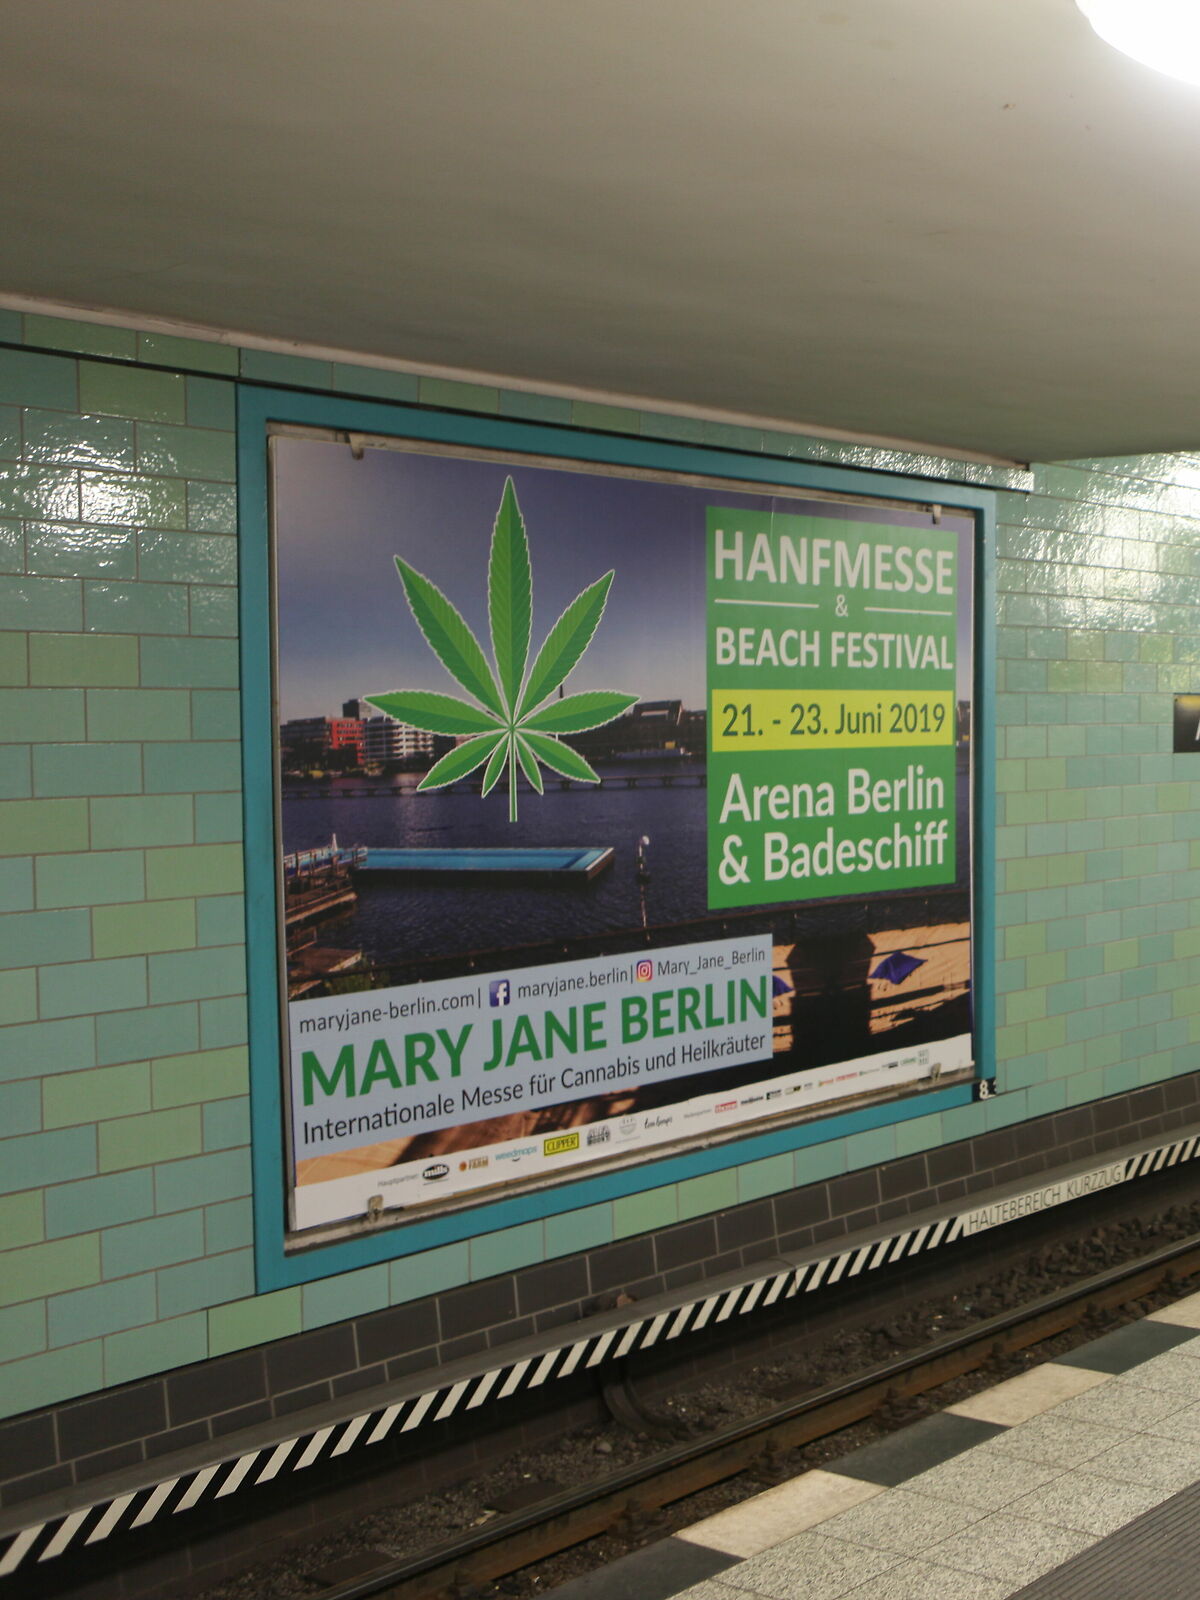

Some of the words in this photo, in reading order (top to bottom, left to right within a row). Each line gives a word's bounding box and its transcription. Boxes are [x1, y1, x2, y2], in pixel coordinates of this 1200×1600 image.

[715, 529, 953, 595] HANFMESSE
[834, 594, 849, 617] &
[716, 626, 820, 667] BEACH
[831, 631, 953, 670] FESTIVAL
[722, 703, 763, 737] 21.
[790, 703, 828, 735] 23.
[835, 703, 882, 735] Juni
[889, 703, 945, 733] 2019
[719, 773, 835, 824] Arena
[848, 765, 944, 815] Berlin
[718, 834, 751, 885] &
[764, 819, 948, 881] Badeschiff
[657, 948, 765, 976] Mary_Jane_Berlin
[301, 1023, 475, 1107] MARY
[483, 1001, 607, 1072] JANE
[621, 975, 768, 1045] BERLIN
[304, 1093, 455, 1145] Internationale
[461, 1082, 523, 1111] Messe
[529, 1074, 556, 1096] für
[561, 1056, 640, 1088] Cannabis
[646, 1048, 676, 1073] und
[682, 1033, 766, 1064] Heilkräuter
[546, 1137, 576, 1152] CLIPPER
[969, 1188, 1061, 1233] HALTEBEREICH
[1066, 1165, 1121, 1198] KURZZUG
